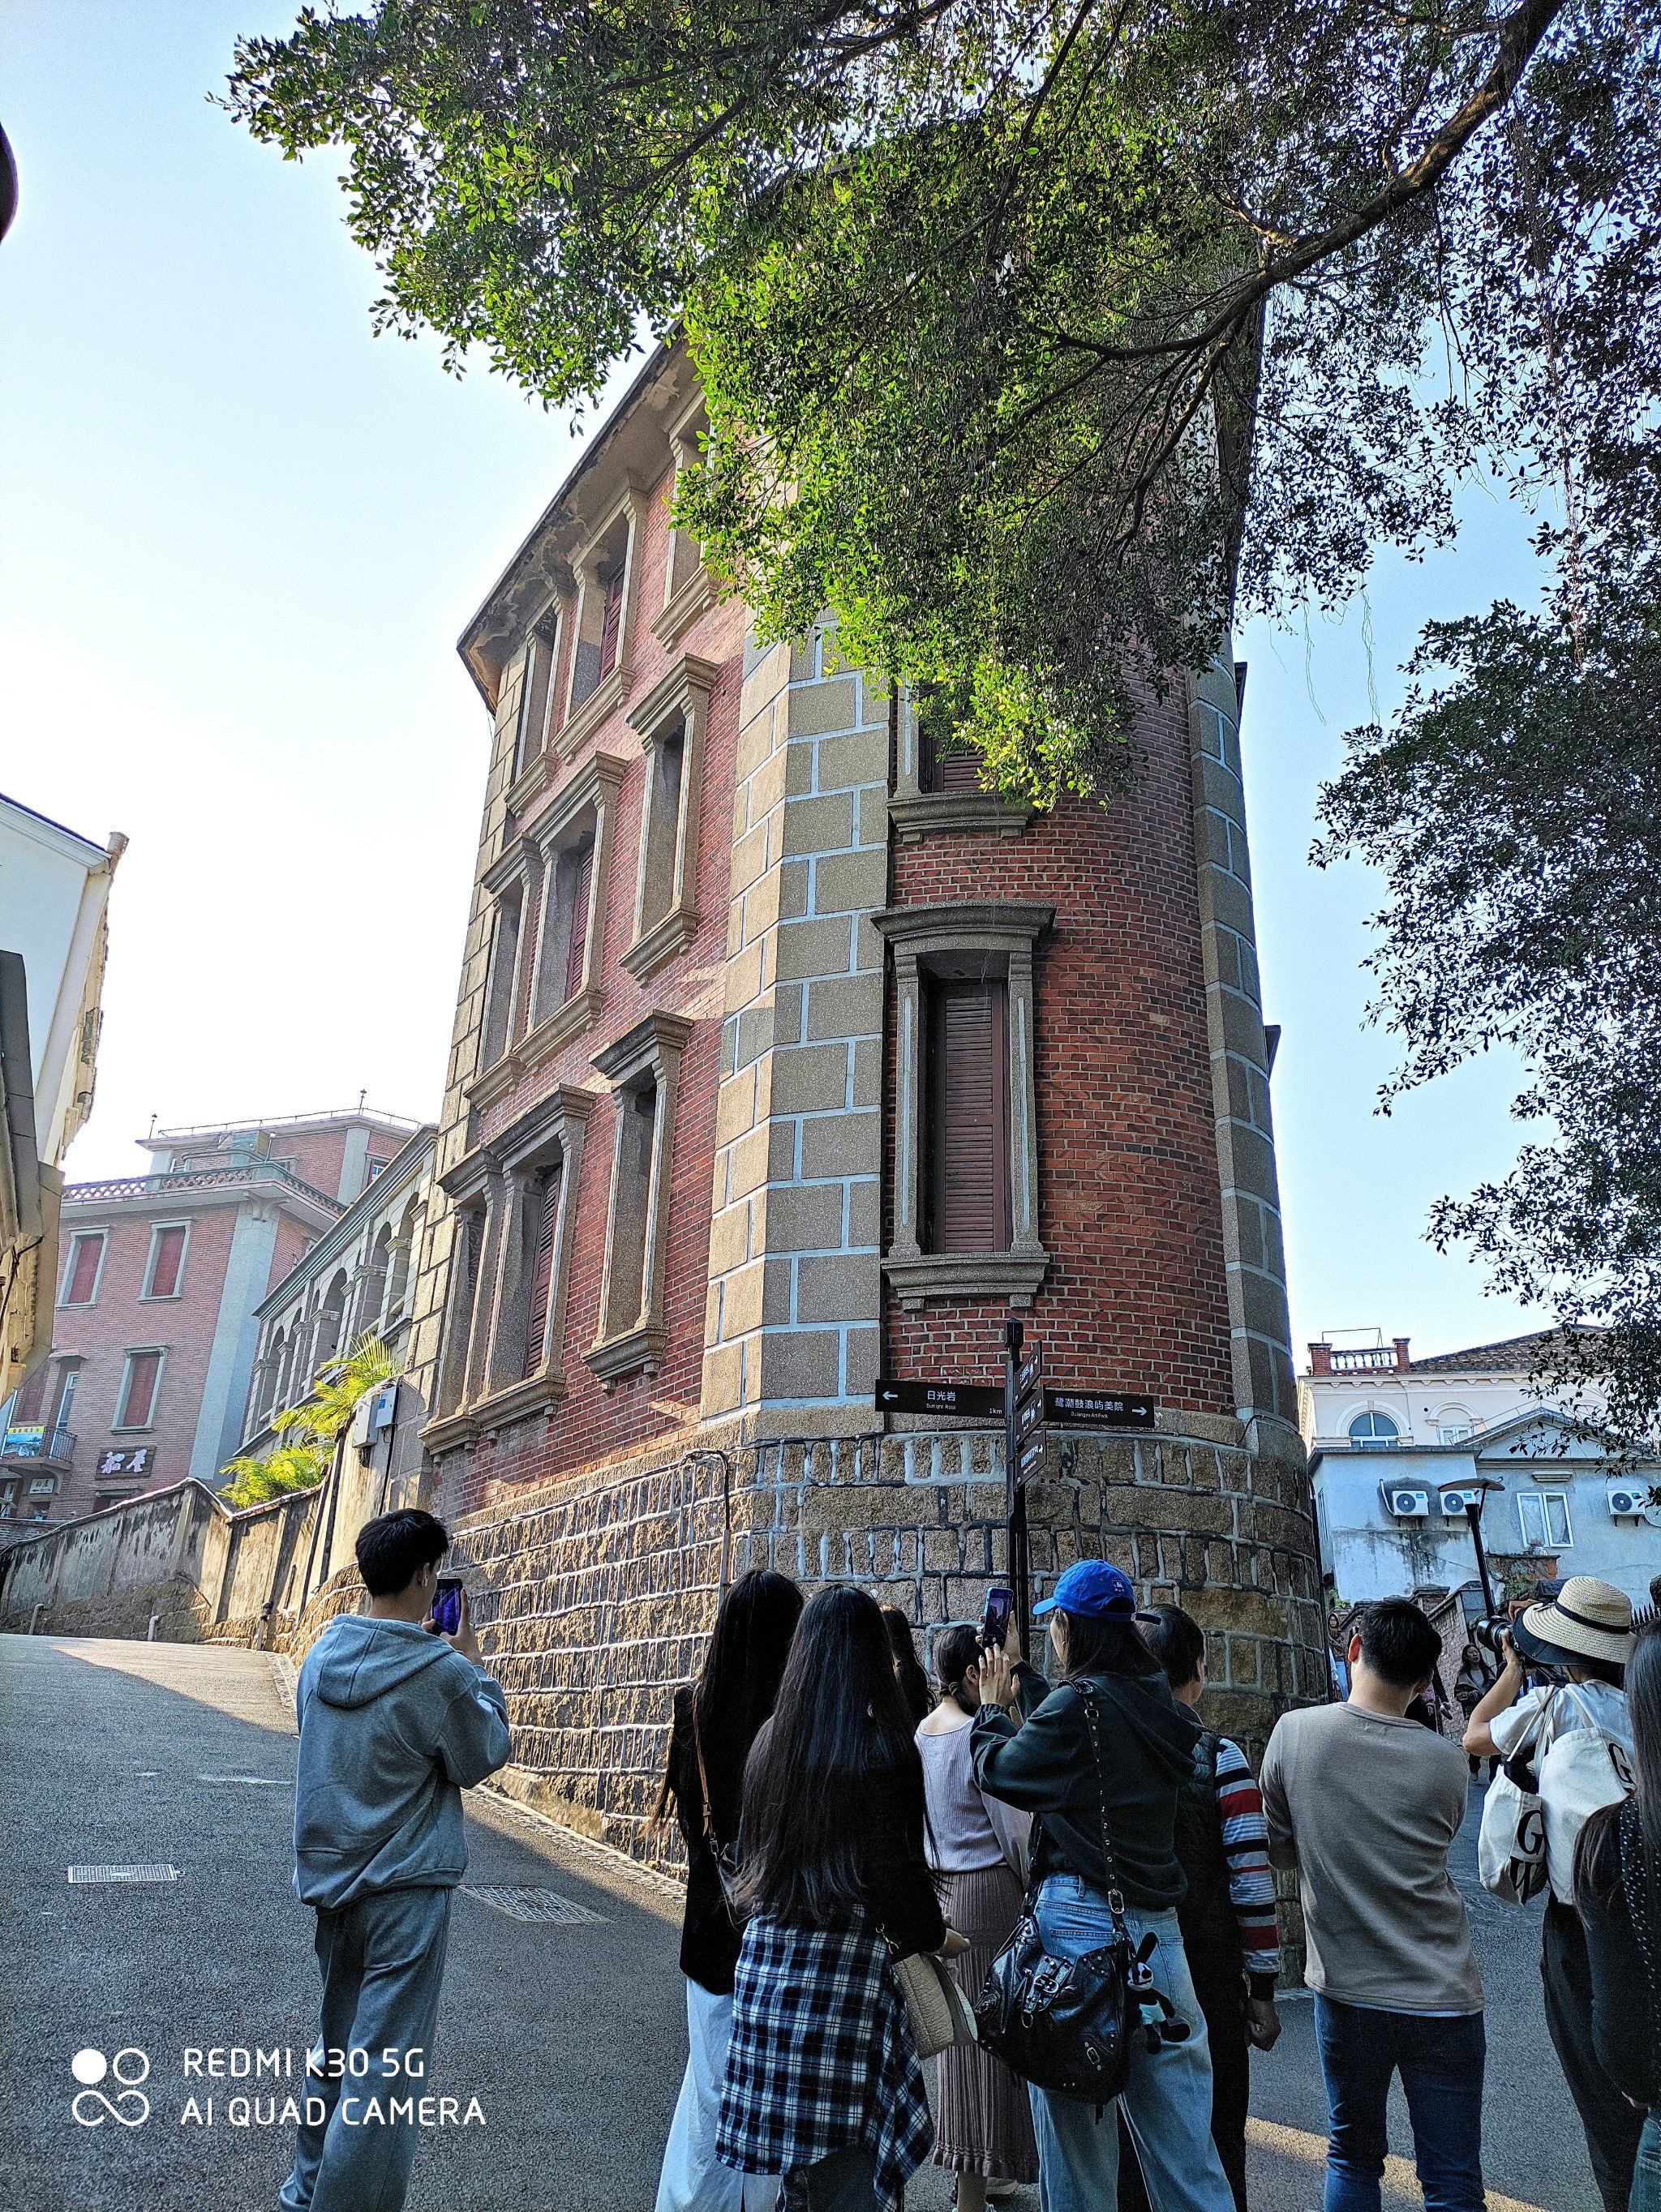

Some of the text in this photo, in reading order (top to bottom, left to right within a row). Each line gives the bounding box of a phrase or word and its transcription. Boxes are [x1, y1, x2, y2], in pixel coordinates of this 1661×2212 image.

[927, 1390, 957, 1402] 日光岩
[1517, 1809, 1543, 1854] G
